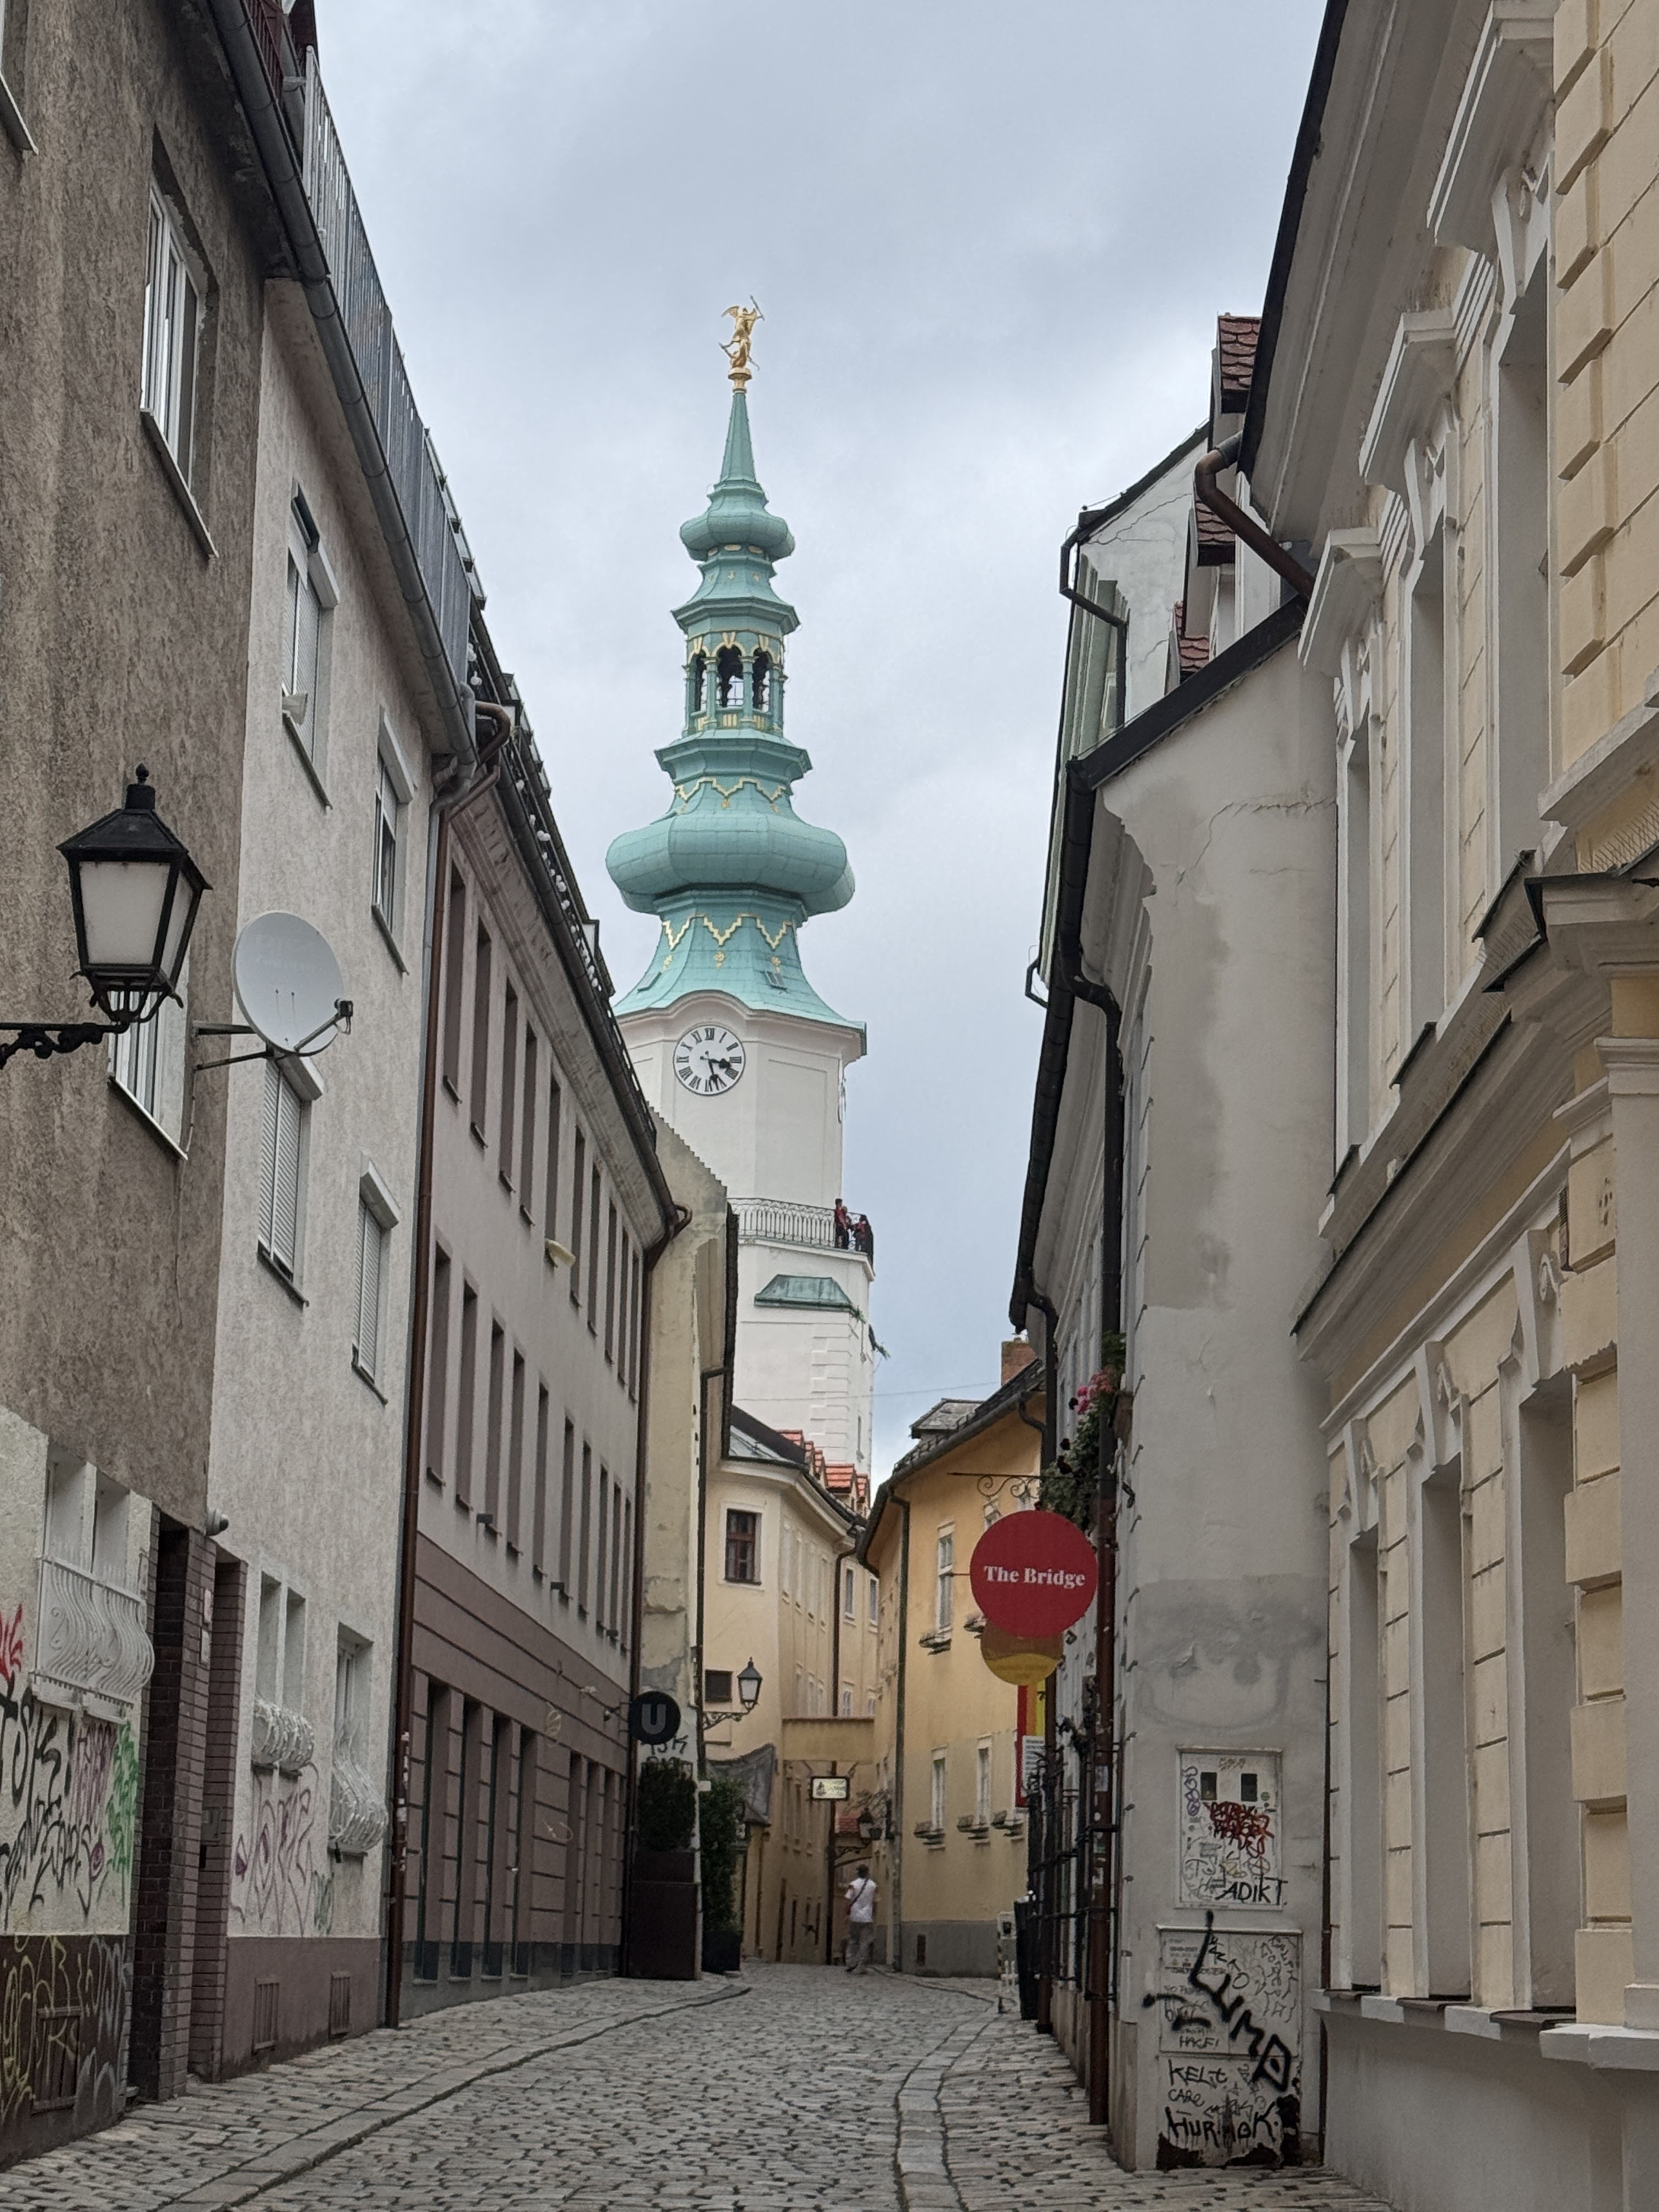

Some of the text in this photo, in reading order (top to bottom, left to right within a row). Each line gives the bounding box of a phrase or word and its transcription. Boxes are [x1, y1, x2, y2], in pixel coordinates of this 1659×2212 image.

[984, 1566, 1086, 1589] The Bridge
[641, 1703, 667, 1735] U
